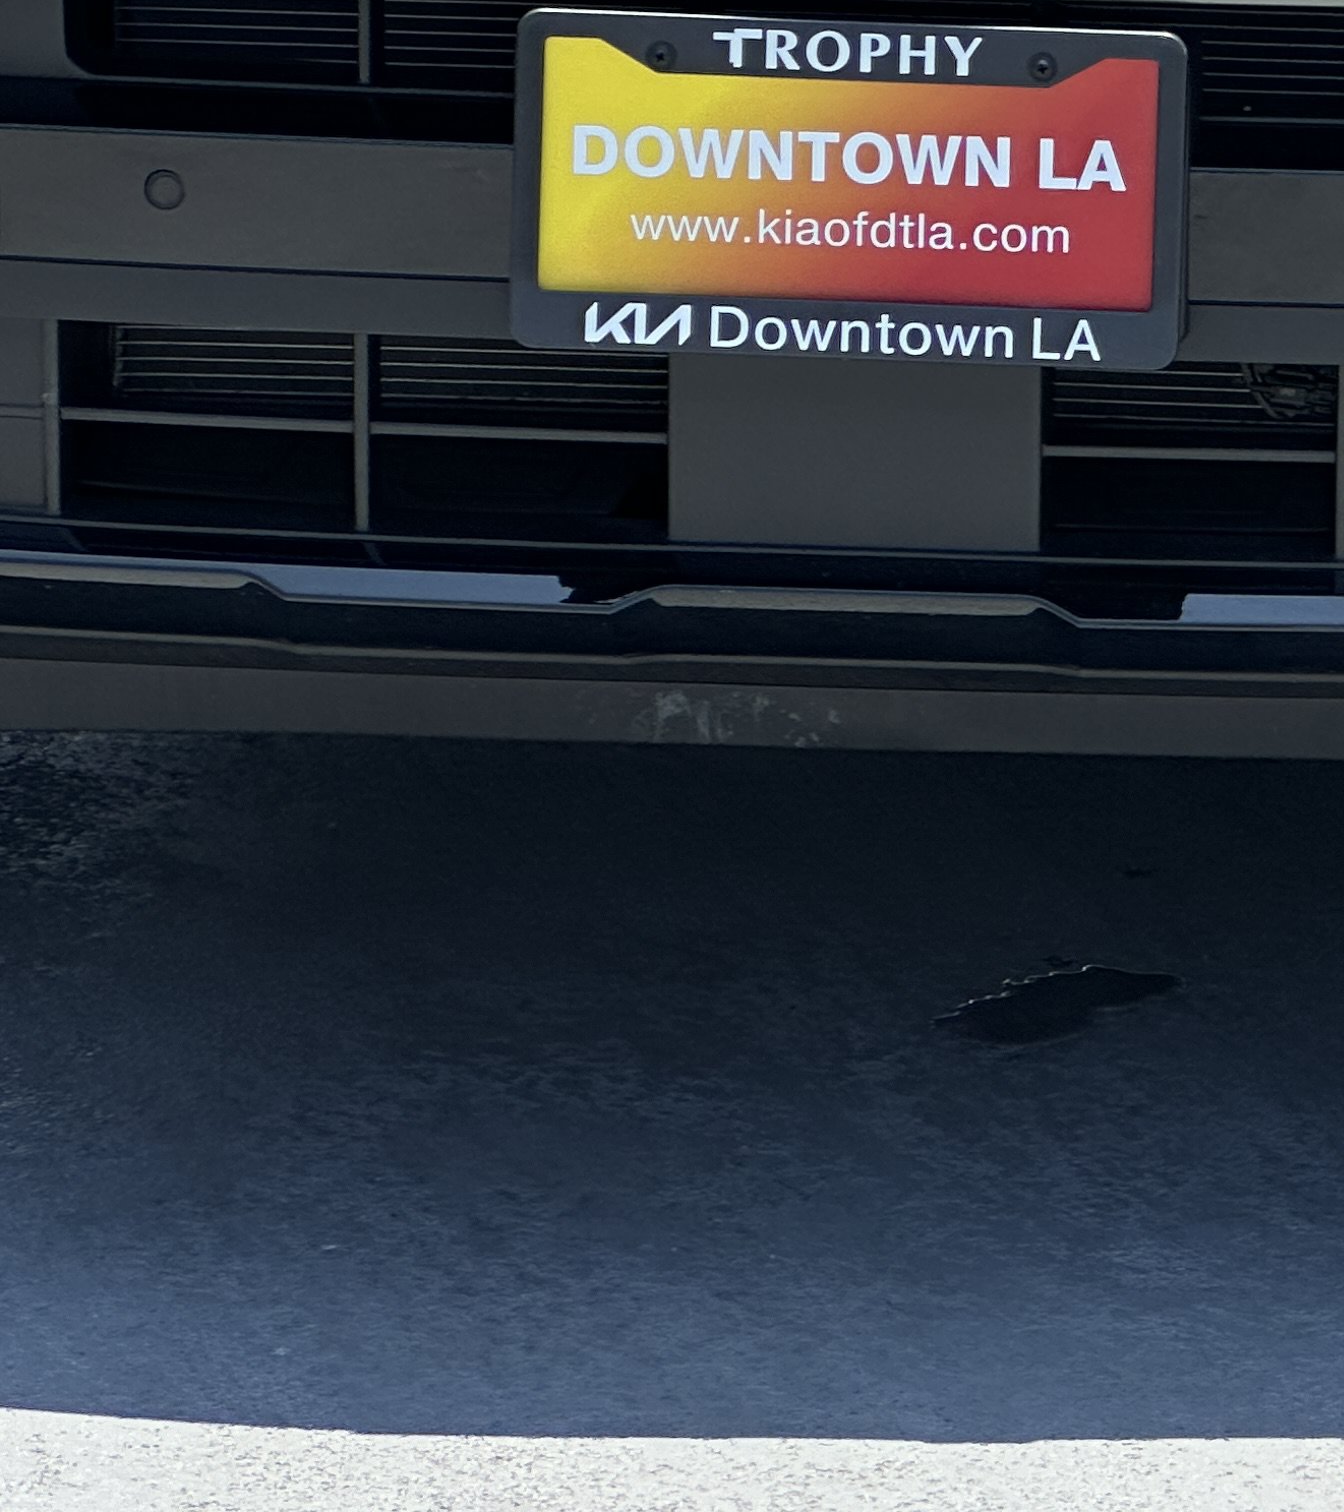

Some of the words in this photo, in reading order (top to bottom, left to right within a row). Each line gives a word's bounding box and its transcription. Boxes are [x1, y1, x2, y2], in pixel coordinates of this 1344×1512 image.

[712, 28, 984, 78] TROPHY
[571, 124, 1012, 189] DOWNTOWN
[1037, 137, 1127, 192] LA
[630, 209, 1071, 254] www.kiaofdtla.com
[708, 305, 1014, 358] Downtown
[1031, 317, 1101, 362] LA
